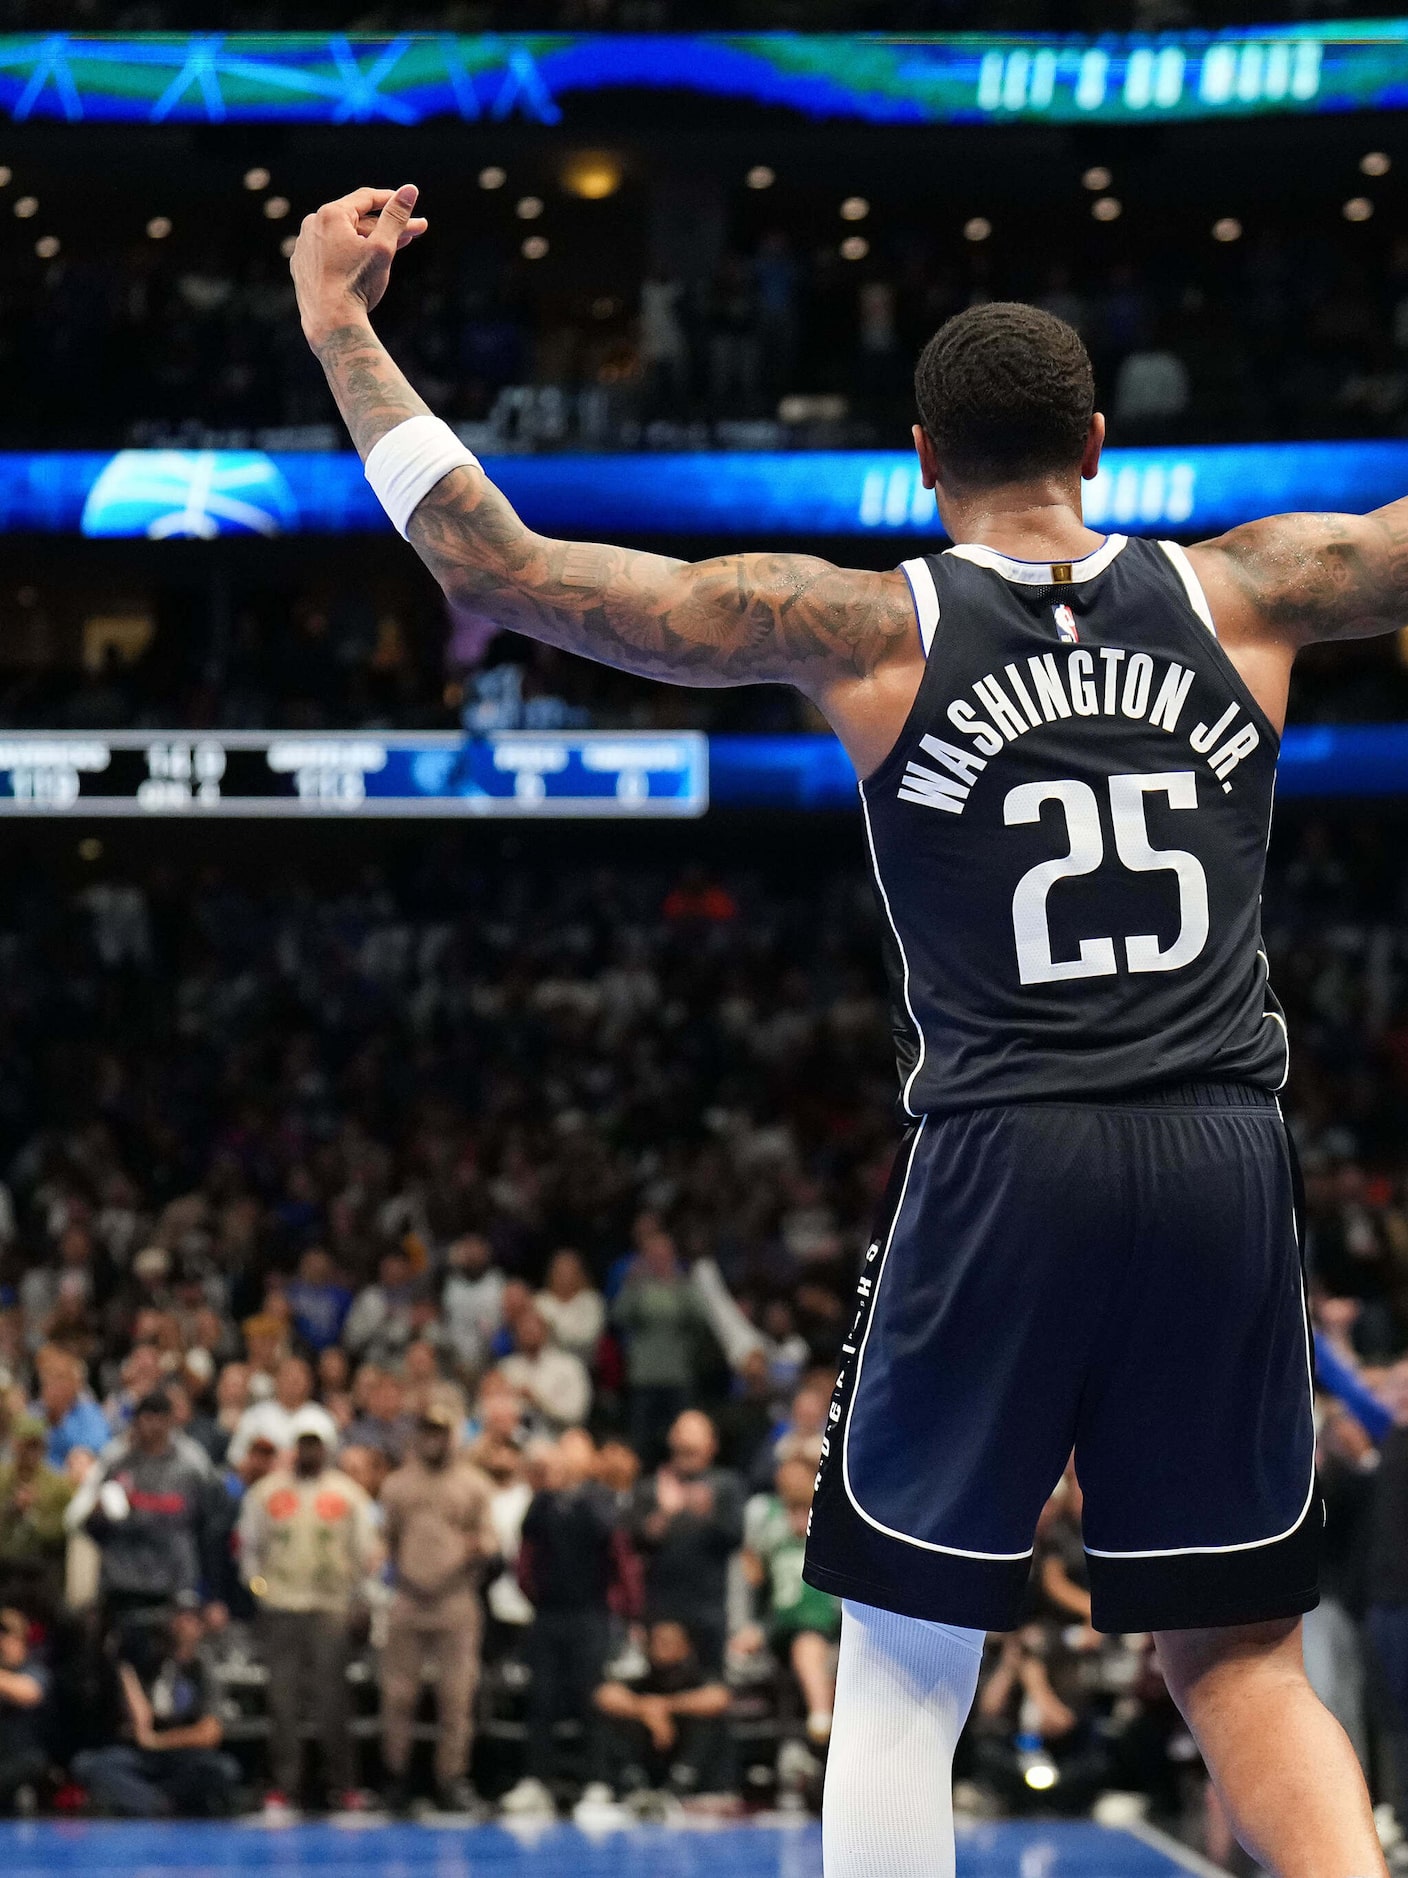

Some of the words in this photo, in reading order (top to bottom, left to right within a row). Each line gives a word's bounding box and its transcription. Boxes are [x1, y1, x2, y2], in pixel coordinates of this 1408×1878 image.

[897, 647, 1195, 814] WASHINGTON
[1189, 701, 1260, 794] JR.
[1003, 771, 1210, 985] 25
